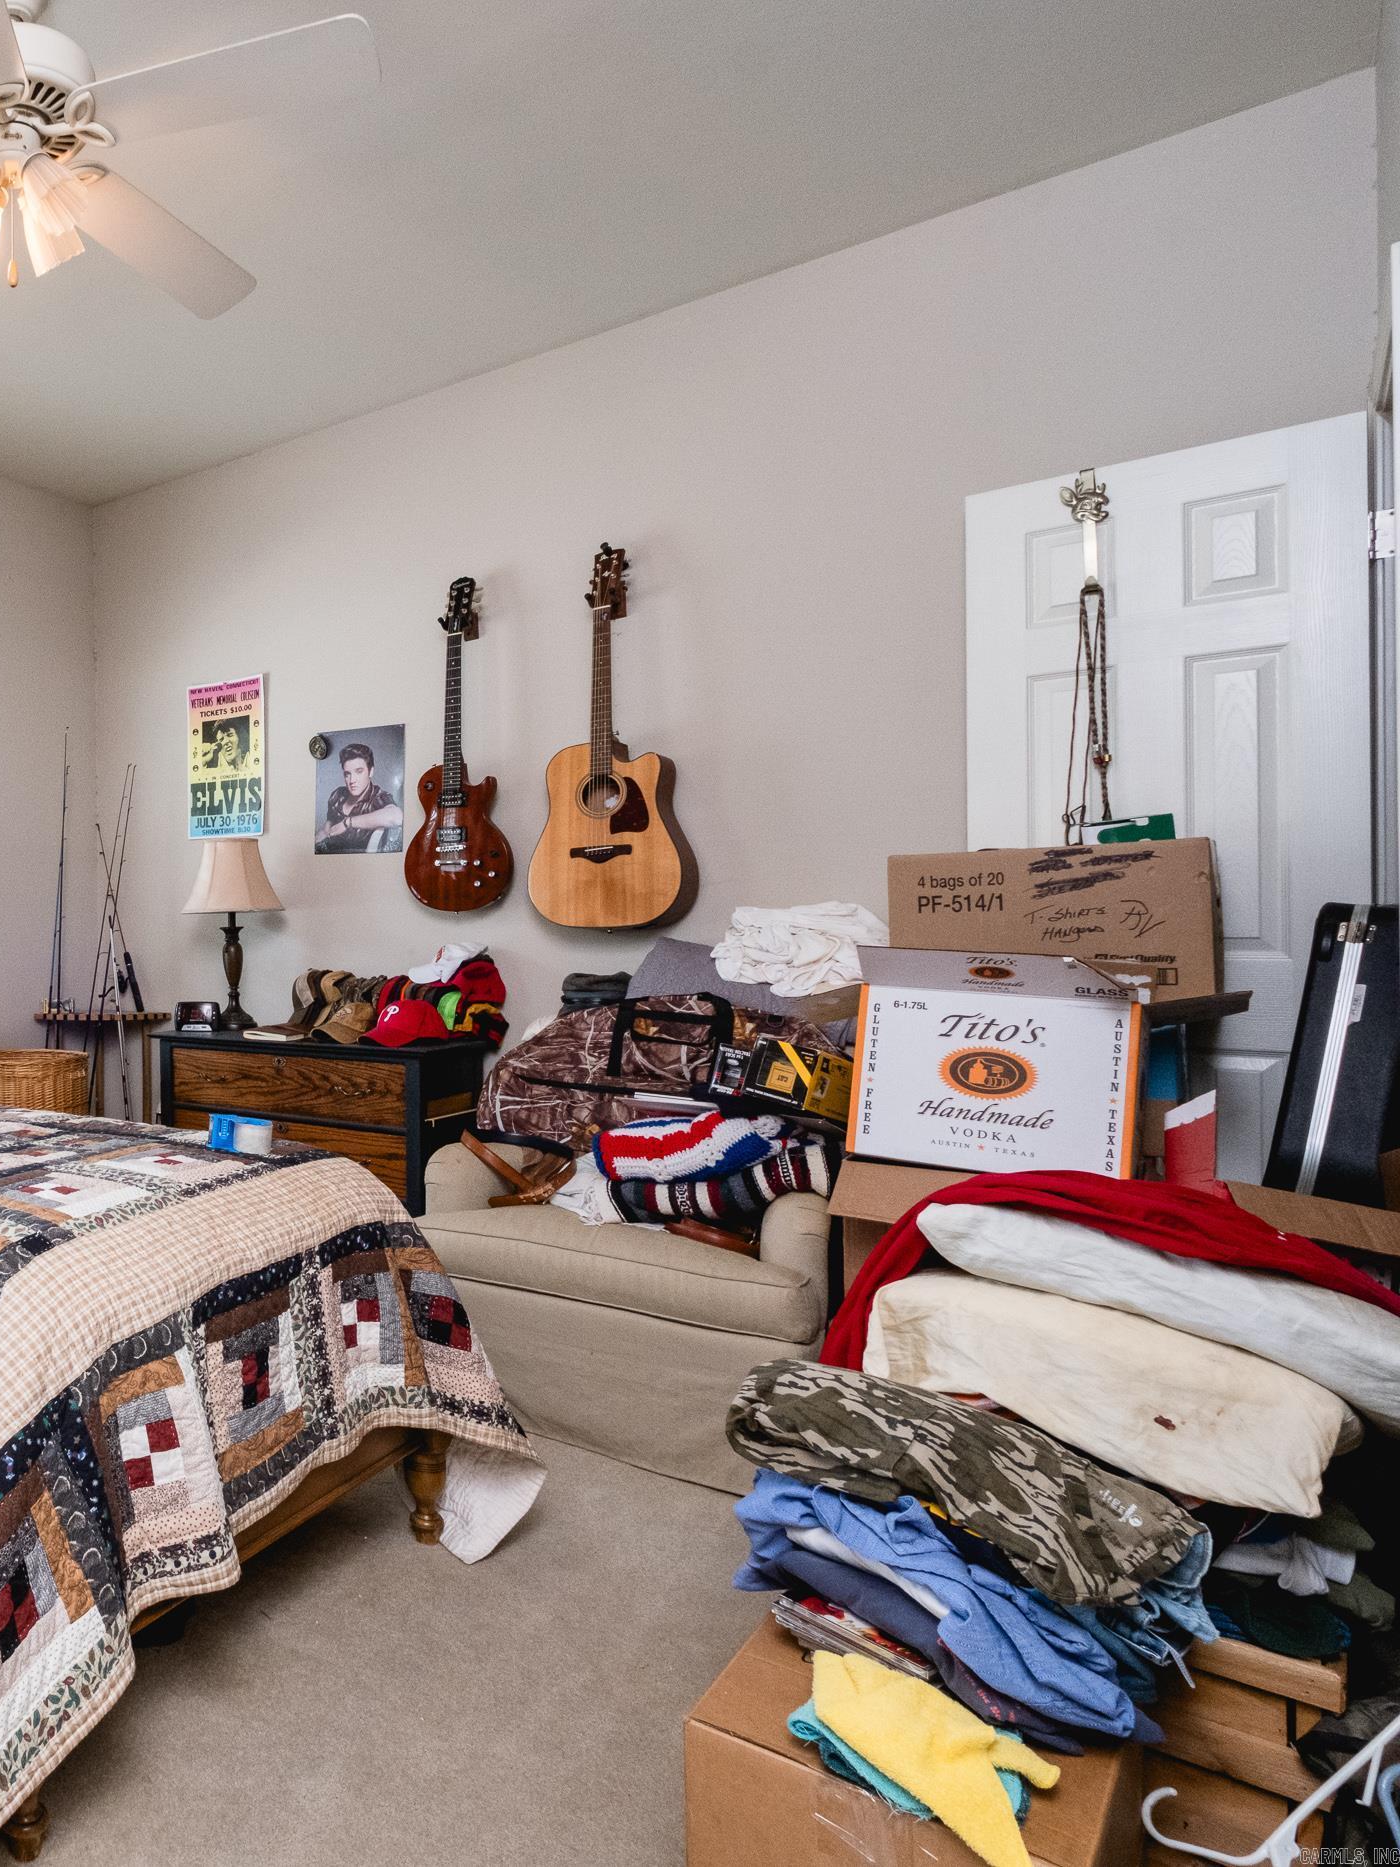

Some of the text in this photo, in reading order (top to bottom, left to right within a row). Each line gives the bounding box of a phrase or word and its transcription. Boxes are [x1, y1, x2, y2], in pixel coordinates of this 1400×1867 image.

[191, 696, 213, 709] VETERANS
[216, 693, 237, 706] MEMORIAL
[200, 703, 253, 718] TICKETS $10.00
[190, 776, 262, 817] ELVIS
[195, 816, 217, 829] JULY
[202, 827, 235, 836] SHOWTIME
[917, 871, 1005, 891] 4 bags of 20
[917, 892, 1004, 914] PF-514/1
[966, 956, 1017, 966] Tito's
[961, 978, 1025, 988] Handmade
[1074, 986, 1129, 997] GLASS
[893, 1000, 929, 1011] 6-1.75L
[937, 1012, 1046, 1045] Tito's
[862, 1002, 881, 1135] GLUTEN FREE
[1105, 1018, 1124, 1172] AUSTIN TEXAS
[917, 1097, 1055, 1131] Handmade
[949, 1126, 1016, 1144] VODKA
[930, 1138, 1036, 1158] AUSTIN TEXAS
